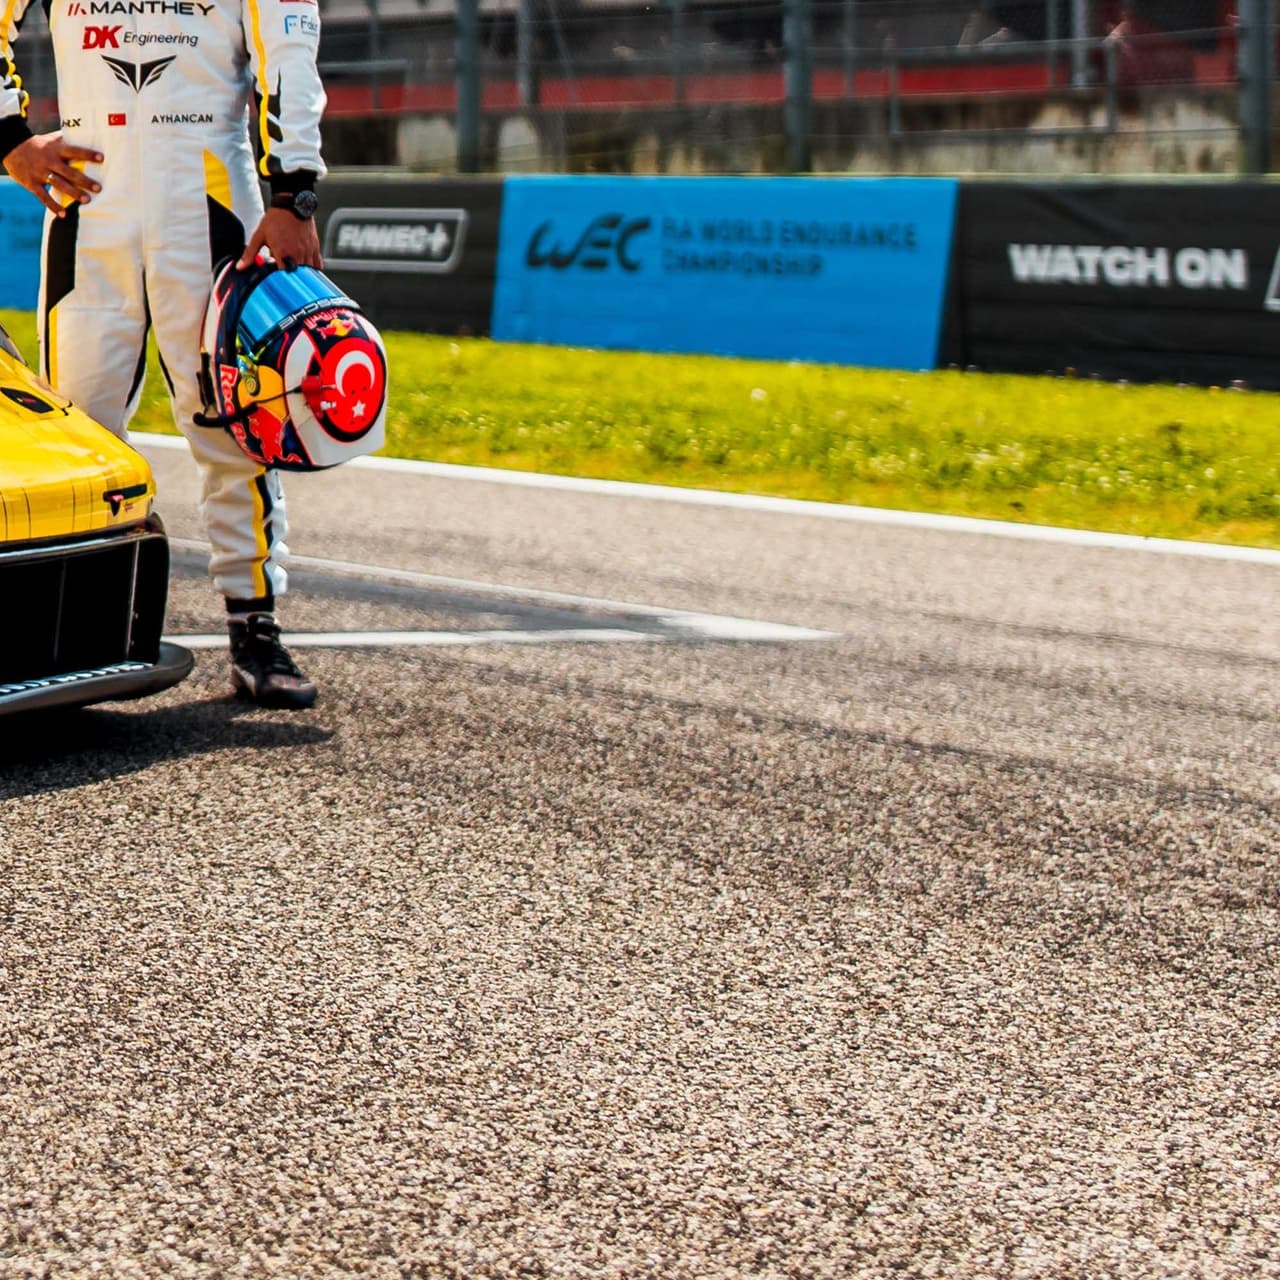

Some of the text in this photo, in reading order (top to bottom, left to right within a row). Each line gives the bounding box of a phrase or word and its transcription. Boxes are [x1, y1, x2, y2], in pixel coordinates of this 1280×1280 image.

[90, 0, 215, 17] MANTHEY
[82, 25, 199, 50] DK Engineering
[151, 113, 214, 124] AYHANCAN
[525, 213, 652, 272] WEC
[699, 218, 774, 245] WORLD
[780, 220, 920, 253] ENDURANCE
[661, 248, 824, 277] CHAMPIONSHIP
[1007, 242, 1248, 290] WATCH ON
